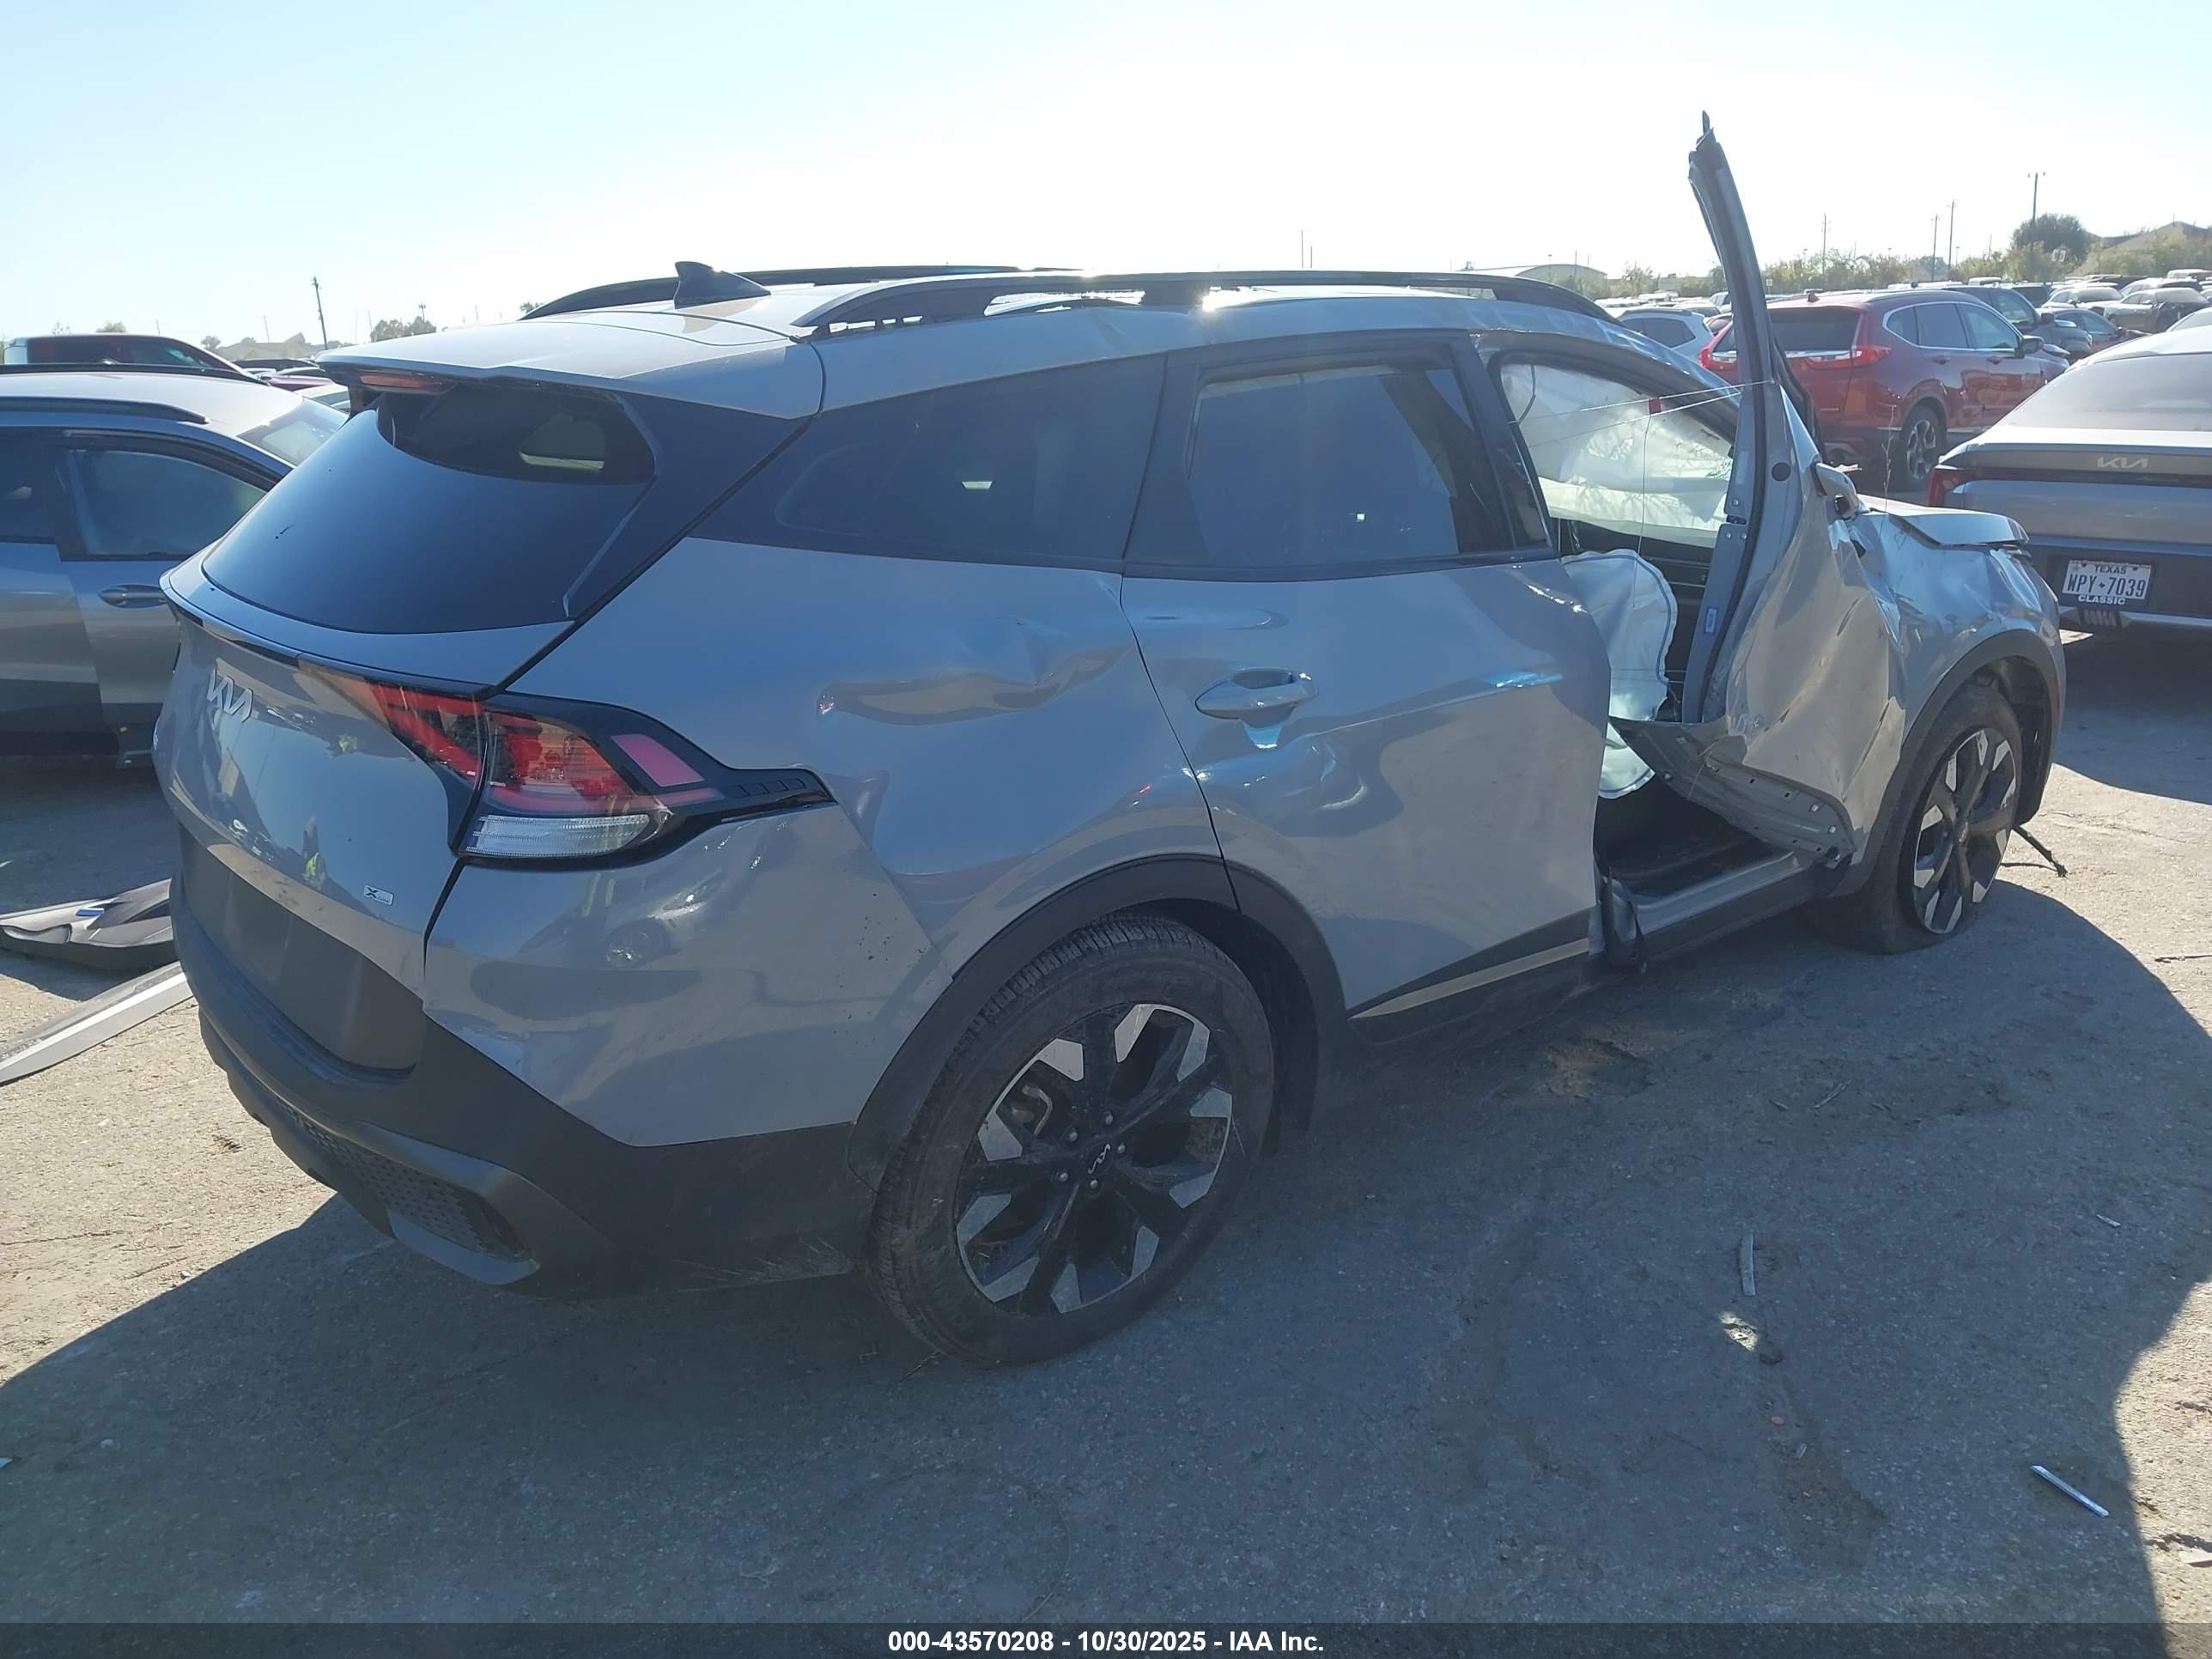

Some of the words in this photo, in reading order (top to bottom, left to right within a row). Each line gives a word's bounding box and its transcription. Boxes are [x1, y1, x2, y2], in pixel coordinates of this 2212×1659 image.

[2098, 456, 2148, 469] KIA
[2094, 564, 2127, 574] TEXAS
[2078, 595, 2126, 605] CLASSIC
[207, 667, 253, 722] KIA
